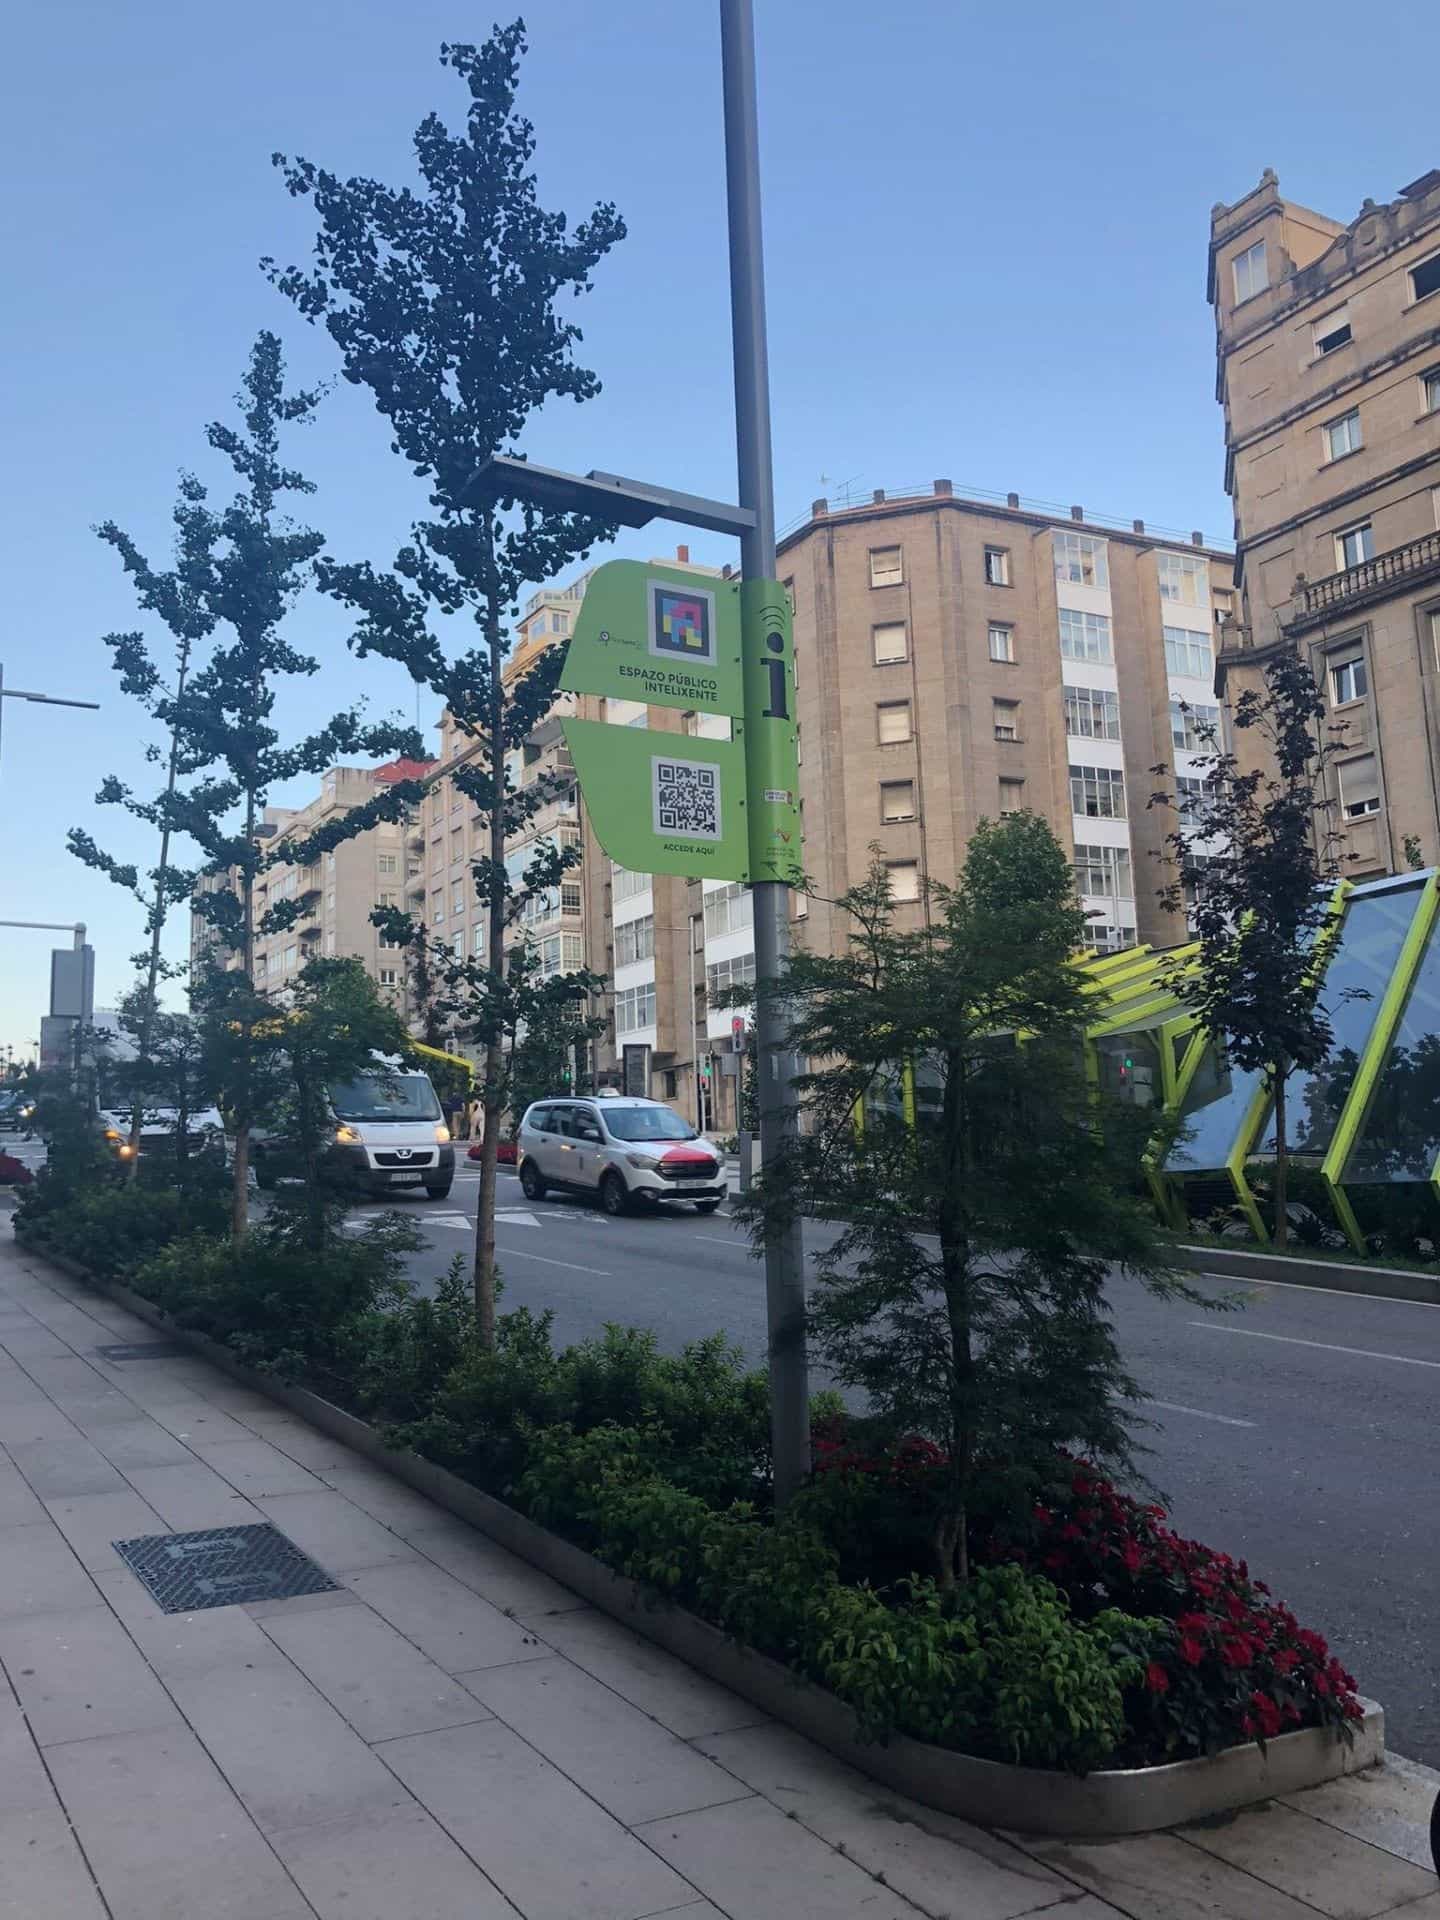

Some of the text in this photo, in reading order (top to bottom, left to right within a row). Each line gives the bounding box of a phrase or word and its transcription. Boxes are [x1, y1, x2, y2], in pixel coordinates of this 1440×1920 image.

[619, 665, 717, 690] ESPAZO PÚBLICO
[645, 681, 718, 702] INTELIXENTE
[663, 843, 695, 853] ACCEDE
